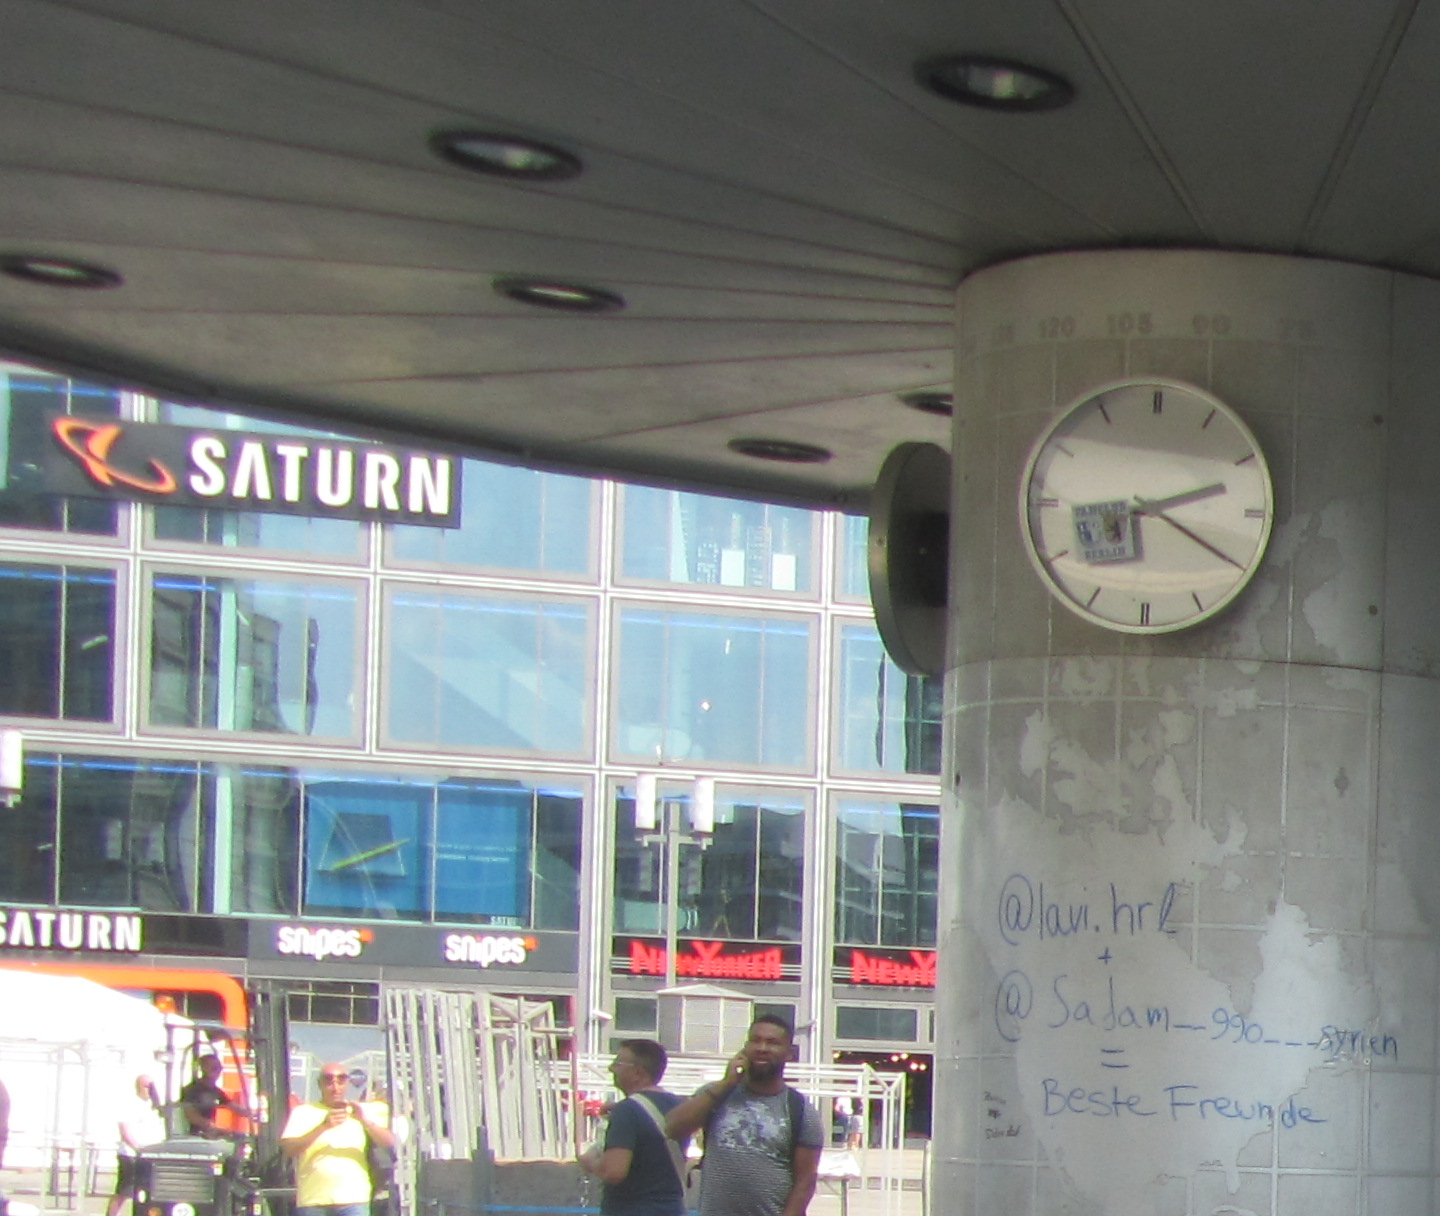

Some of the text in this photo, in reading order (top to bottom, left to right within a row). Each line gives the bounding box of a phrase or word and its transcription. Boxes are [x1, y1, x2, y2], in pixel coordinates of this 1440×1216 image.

[188, 435, 452, 516] SATURN
[278, 926, 363, 961] snipes
[445, 934, 528, 968] snipes
[1042, 1079, 1328, 1129] Beste Freunde
